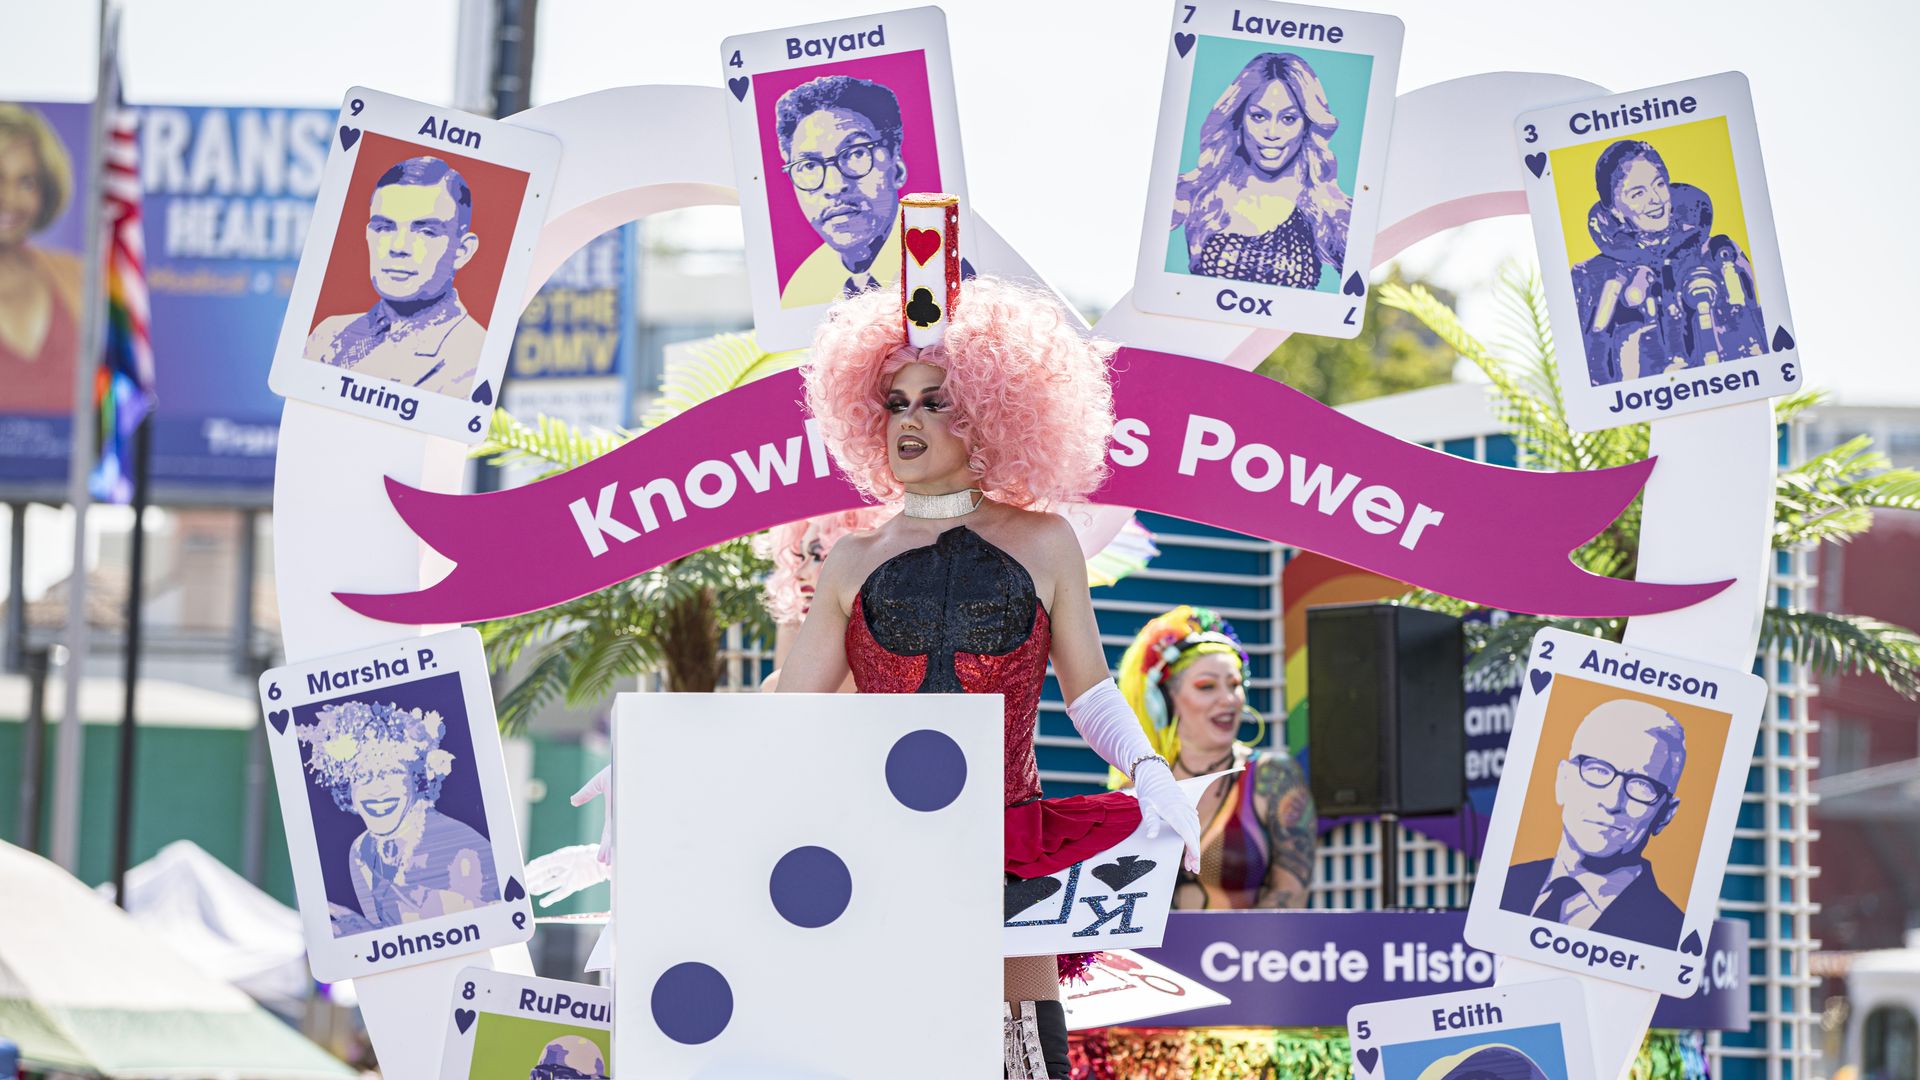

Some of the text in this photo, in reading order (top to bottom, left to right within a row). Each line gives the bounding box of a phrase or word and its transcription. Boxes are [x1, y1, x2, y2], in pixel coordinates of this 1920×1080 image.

[1183, 5, 1196, 24] 7
[1232, 10, 1344, 43] Laverne
[786, 25, 885, 59] Bayard
[729, 50, 743, 68] 4
[350, 99, 364, 116] 9
[1569, 96, 1697, 134] Christine
[418, 116, 482, 149] Alan
[1524, 125, 1539, 143] 3
[1216, 289, 1273, 316] Cox
[1343, 307, 1356, 325] 7
[515, 329, 619, 375] DMV
[1780, 363, 1796, 382] 3
[339, 376, 419, 420] Turing
[1609, 369, 1760, 413] Jorgensen
[1178, 414, 1445, 551] Power
[1538, 641, 1555, 660] 2
[307, 649, 438, 694] Marsha P.
[1580, 650, 1718, 700] Anderson
[268, 682, 282, 700] 6
[1072, 892, 1148, 937] K
[366, 923, 480, 962] Johnson
[1527, 927, 1639, 970] Cooper
[1200, 941, 1369, 983] Create
[1383, 942, 1497, 983] Histo
[1677, 965, 1694, 984] 2
[462, 981, 475, 1000] 8
[1357, 1021, 1371, 1040] 5
[1432, 1003, 1503, 1031] Edith
